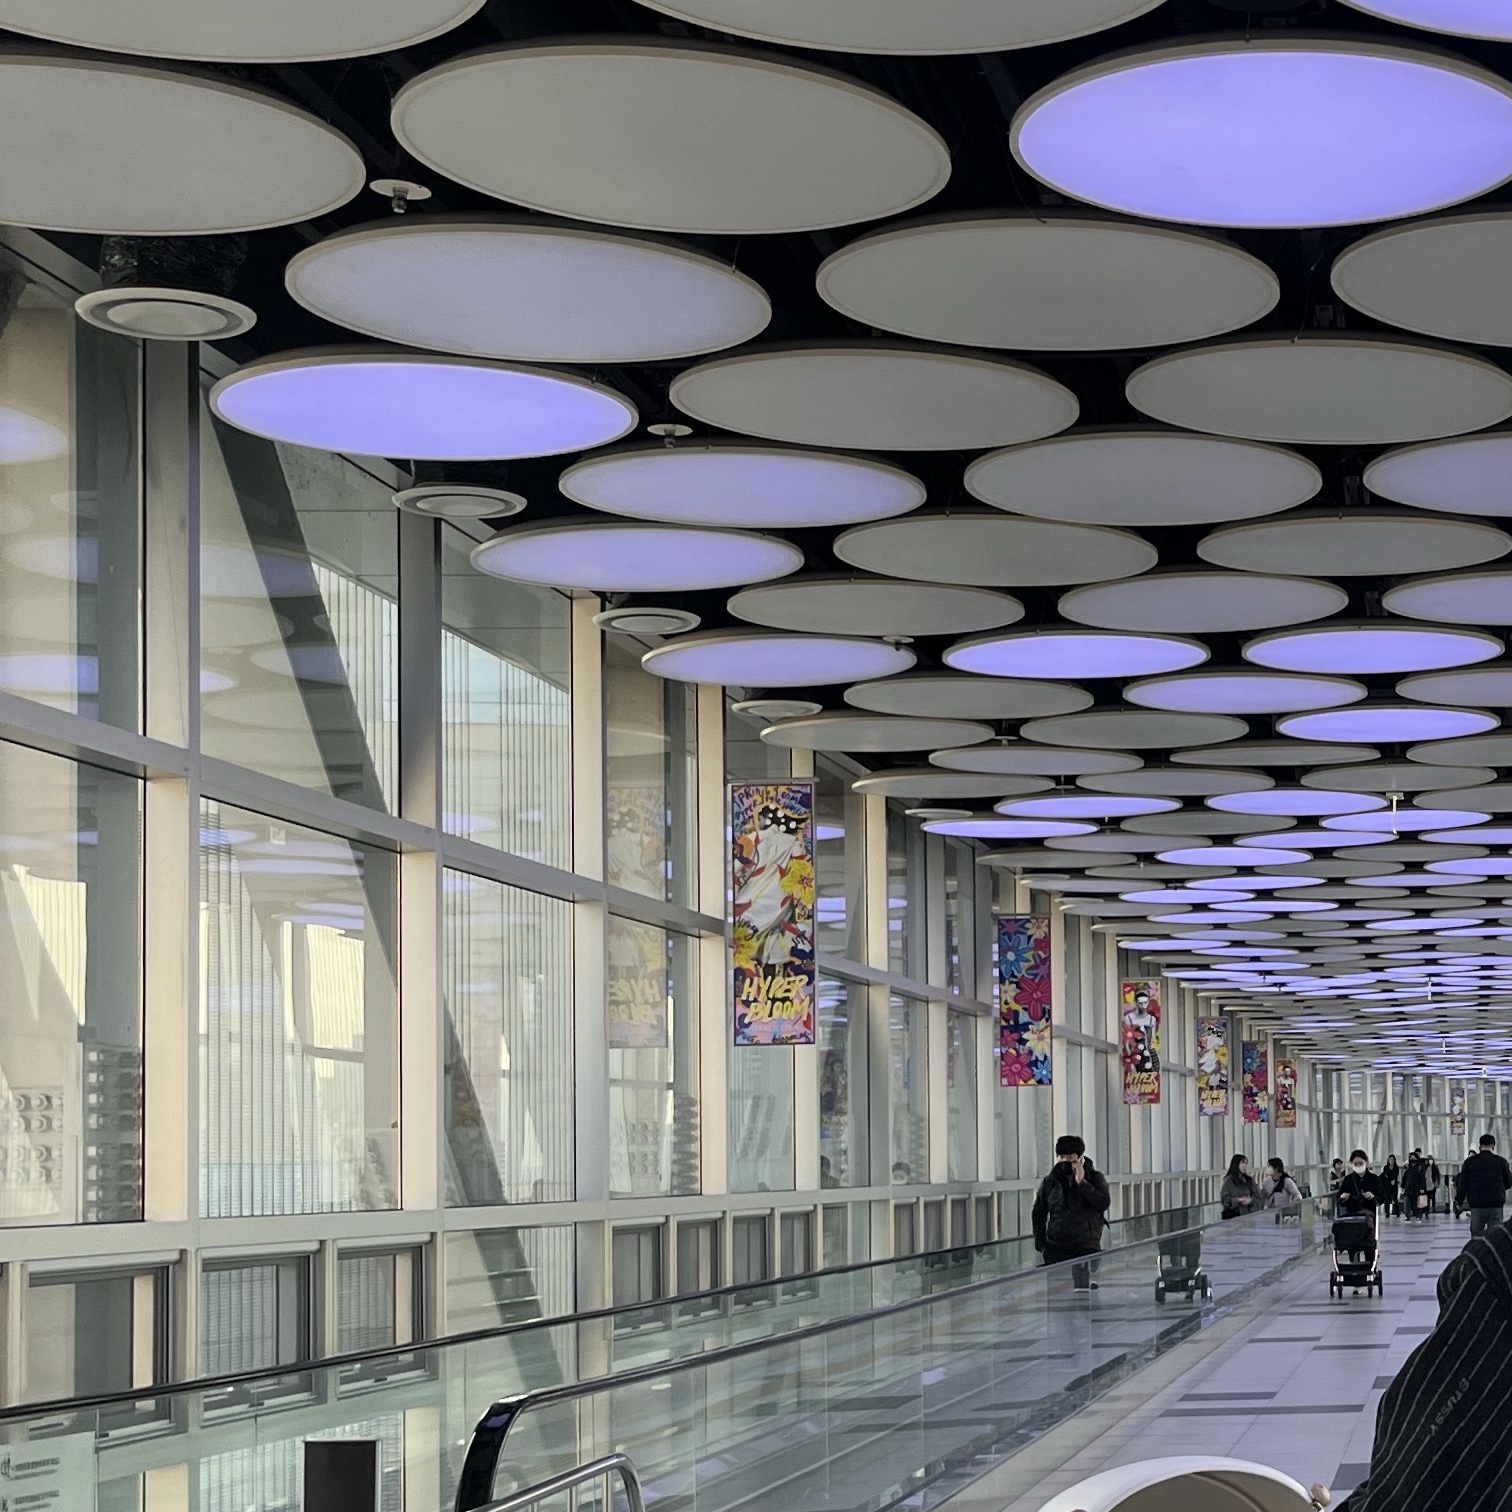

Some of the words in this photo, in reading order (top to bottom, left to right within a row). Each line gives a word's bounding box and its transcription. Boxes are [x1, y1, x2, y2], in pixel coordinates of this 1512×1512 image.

[742, 975, 809, 1001] HYPER
[744, 996, 810, 1023] BLOOM
[1430, 1377, 1470, 1436] STUSSY
